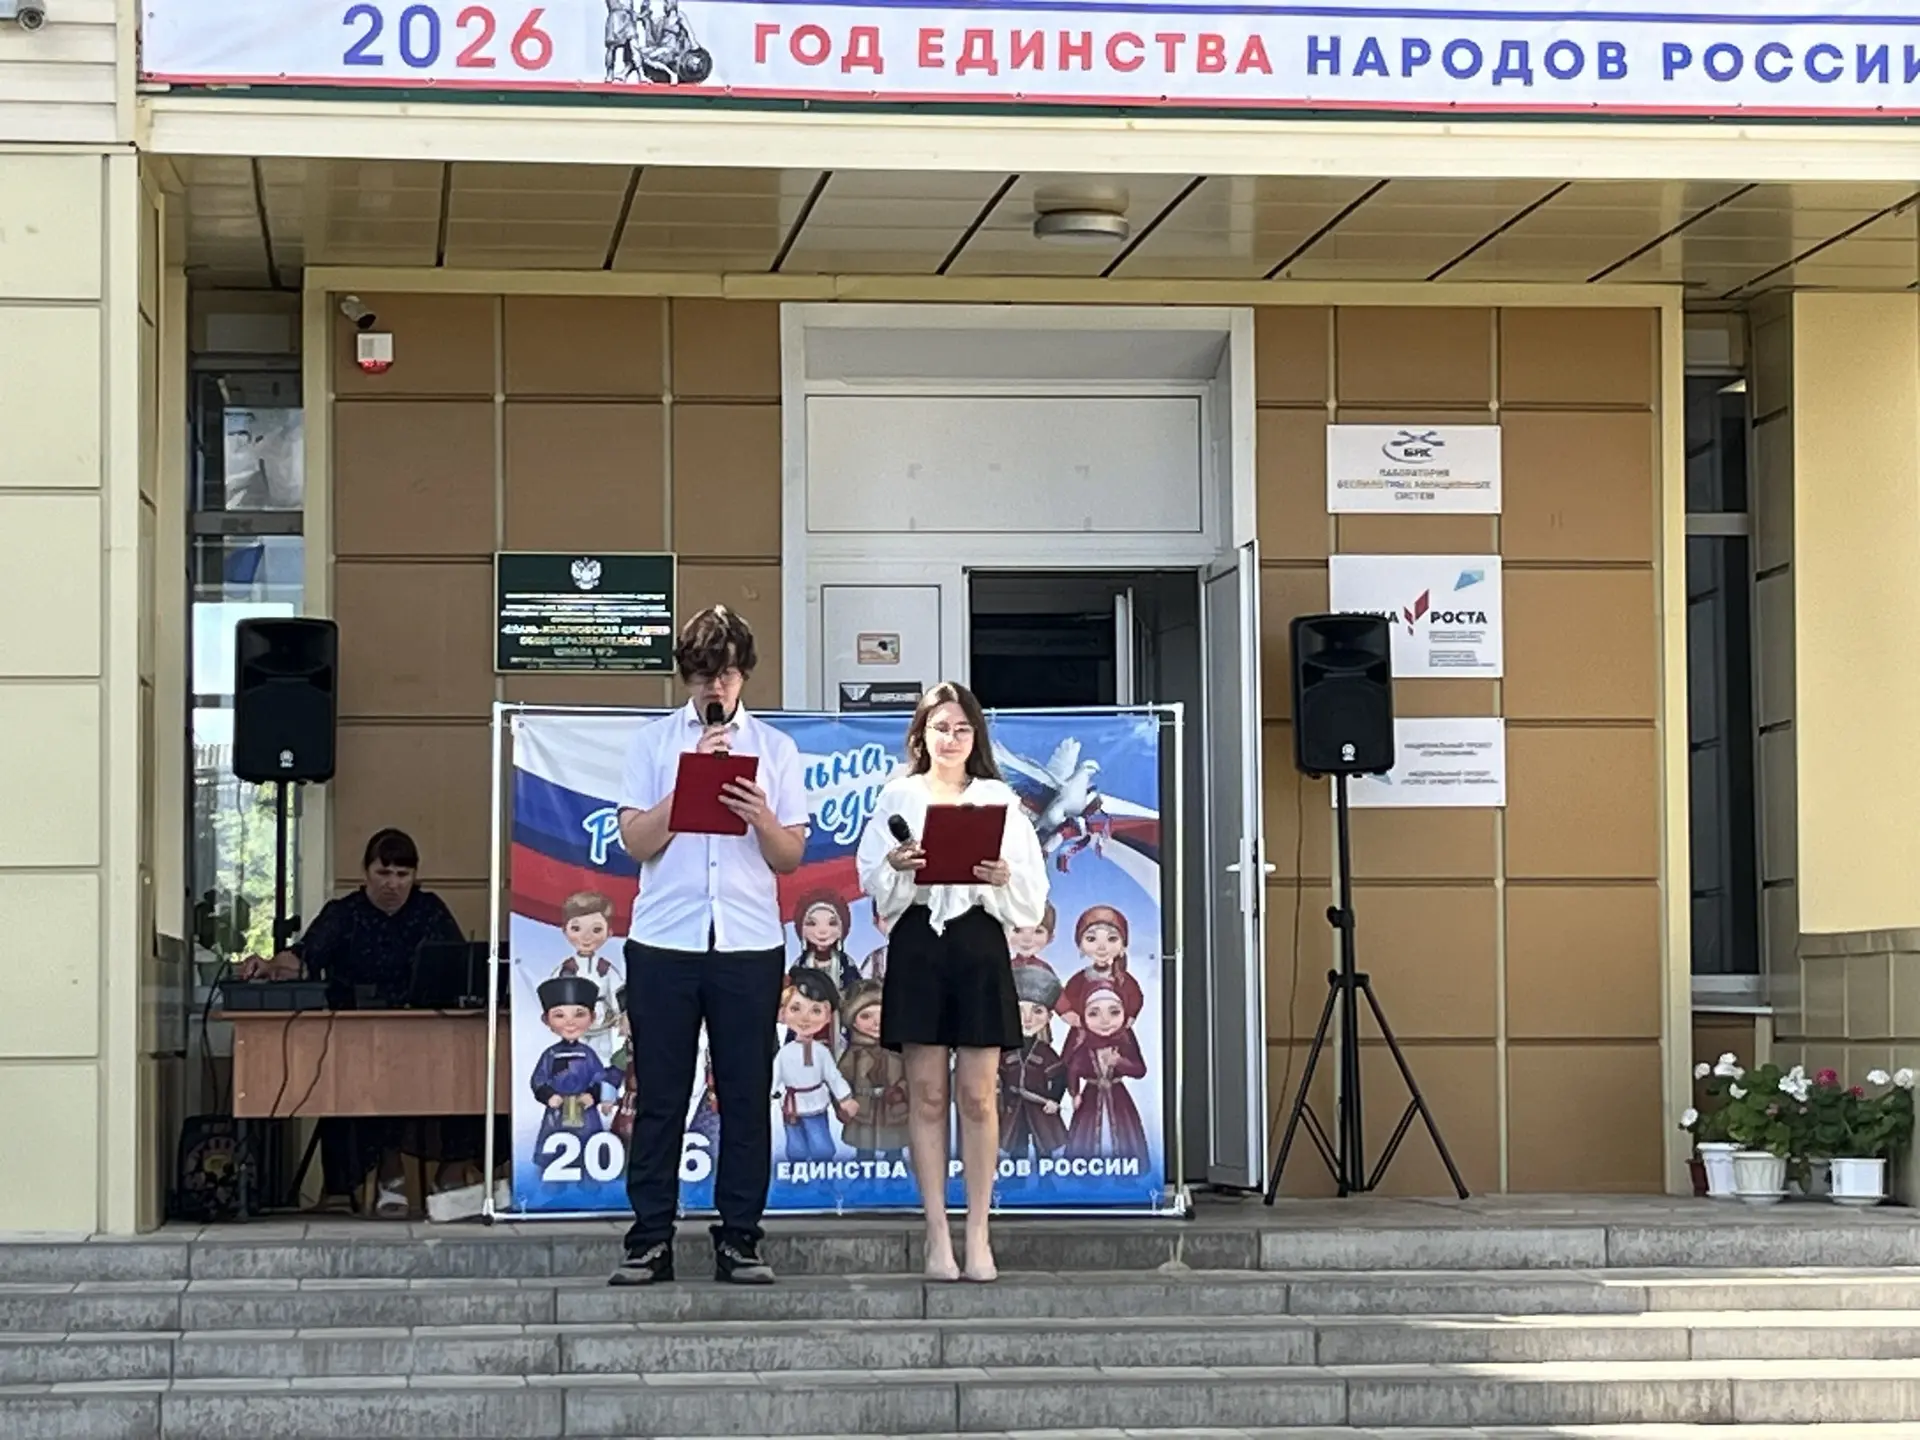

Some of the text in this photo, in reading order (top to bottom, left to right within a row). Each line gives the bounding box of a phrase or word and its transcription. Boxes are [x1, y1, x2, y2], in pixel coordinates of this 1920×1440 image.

[343, 4, 553, 71] 2026
[755, 23, 884, 75] ГОД
[917, 28, 1273, 76] ЕДИНСТВА
[1307, 35, 1628, 86] НАРОДОВ
[1430, 611, 1488, 624] РОСТА
[541, 1131, 712, 1182] 206
[776, 1160, 908, 1184] ЕДИНСТВА
[1039, 1158, 1139, 1176] РОССИИ
